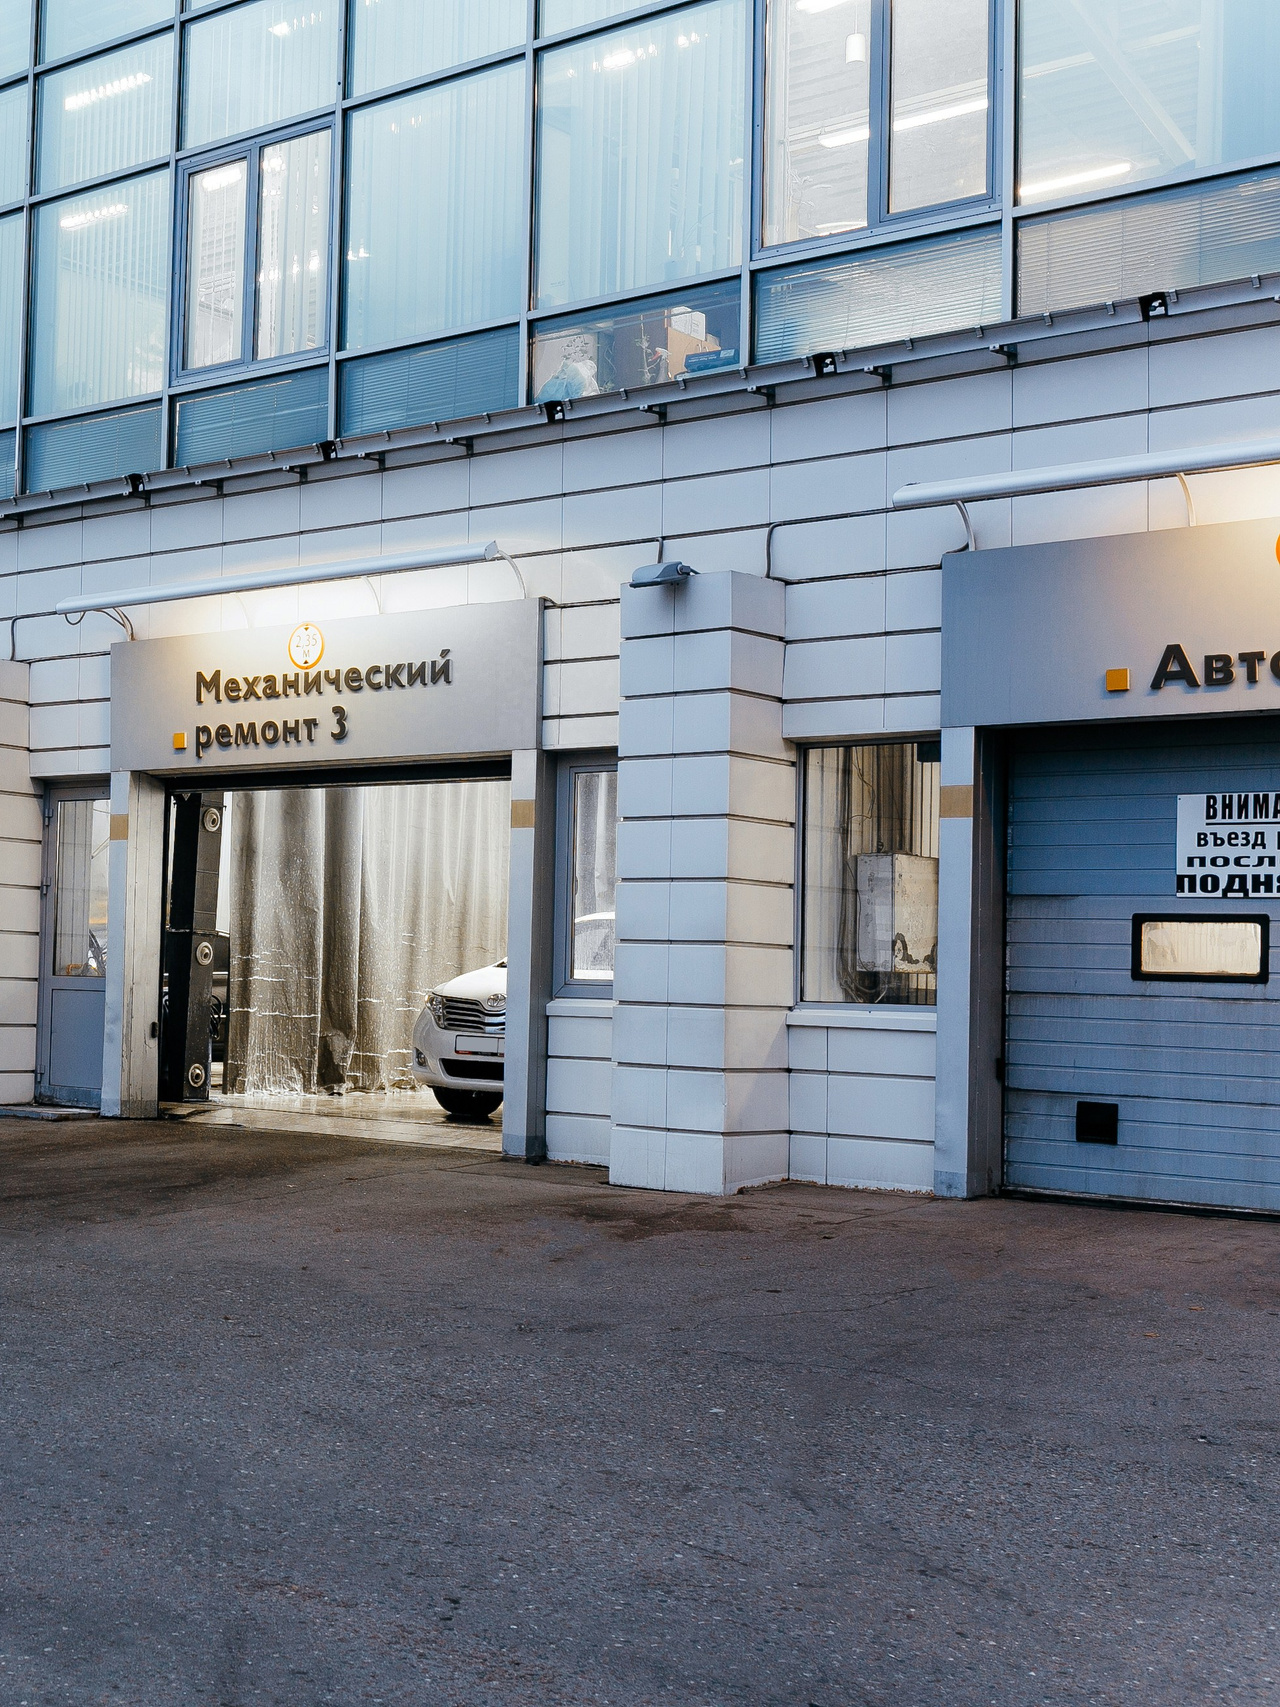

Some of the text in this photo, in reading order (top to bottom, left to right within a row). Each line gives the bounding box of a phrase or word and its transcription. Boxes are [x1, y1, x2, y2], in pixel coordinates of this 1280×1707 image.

[296, 633, 318, 649] 2,35
[195, 648, 454, 703] Механический
[195, 705, 348, 758] ремонт 3
[1177, 874, 1280, 898] подн
